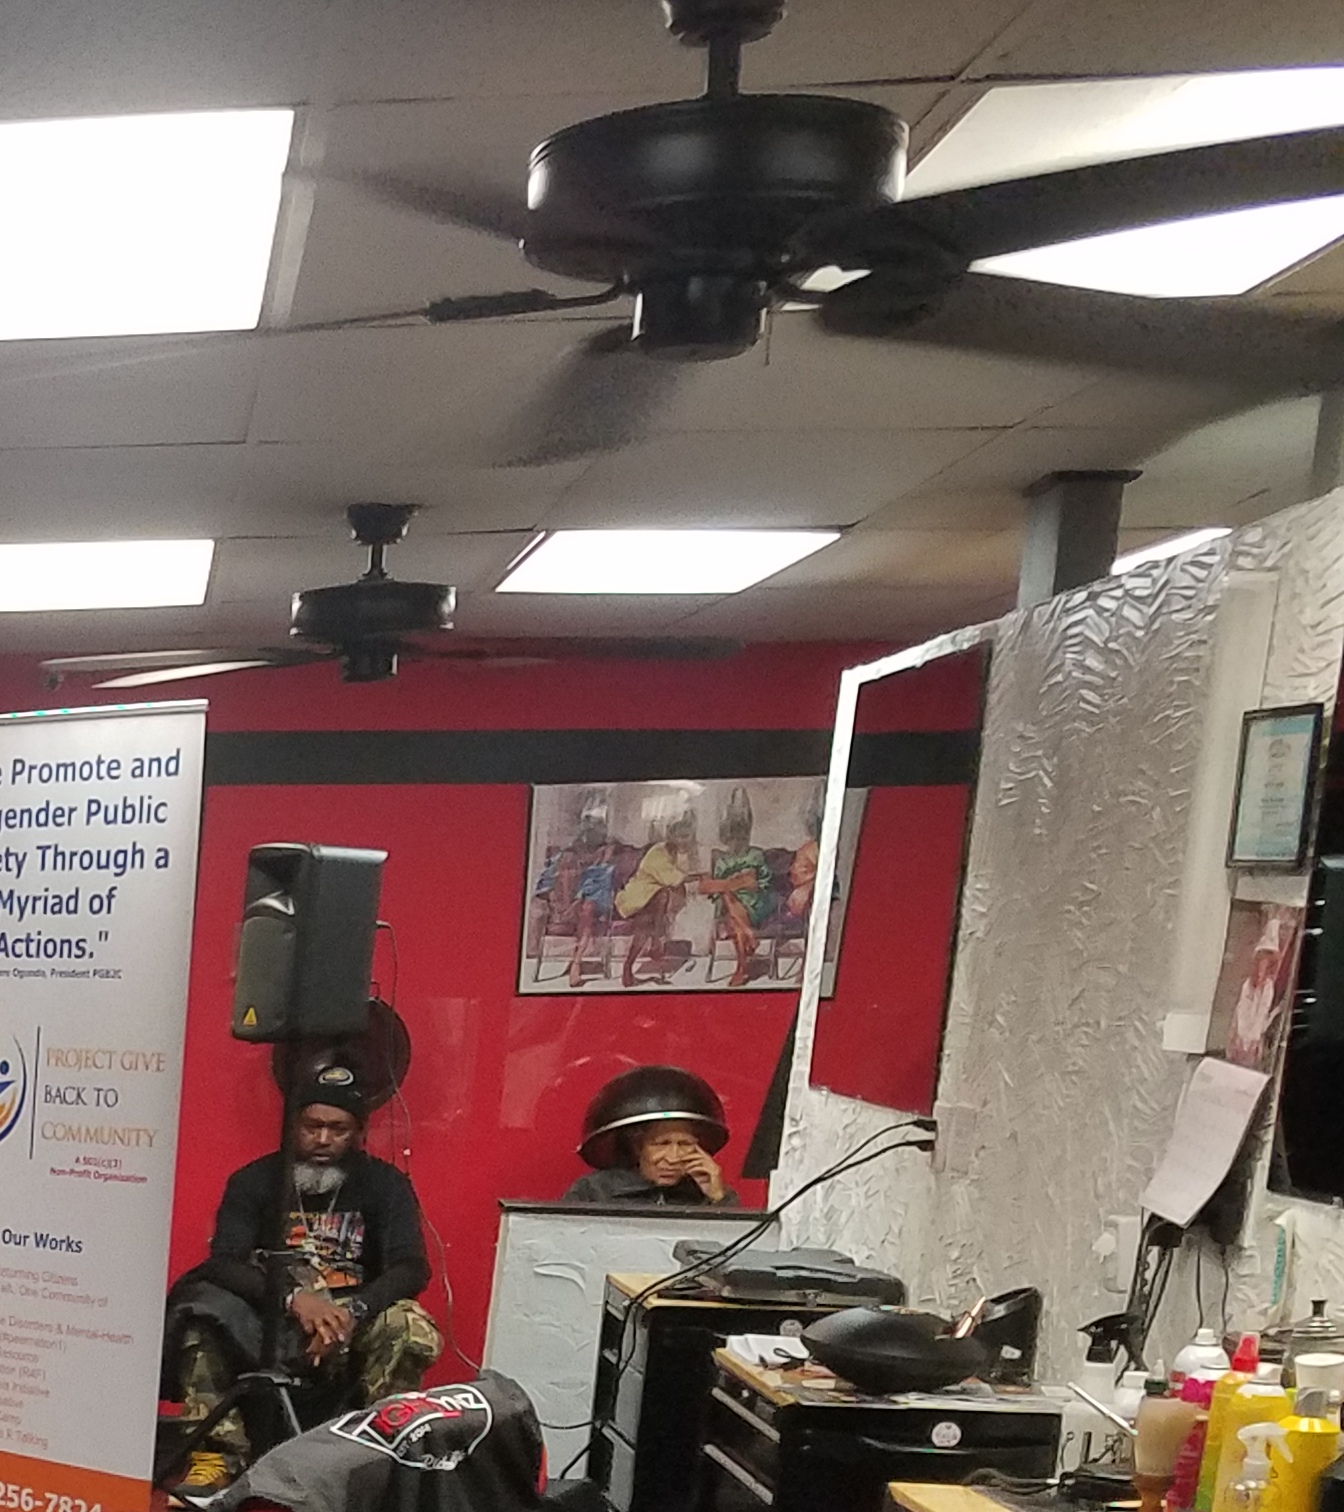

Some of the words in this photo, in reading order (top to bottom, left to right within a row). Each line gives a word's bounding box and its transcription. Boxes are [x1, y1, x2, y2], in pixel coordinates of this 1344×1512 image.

[11, 754, 122, 785] Promote
[131, 748, 181, 779] and
[86, 796, 168, 826] Public
[37, 842, 145, 877] Through
[155, 848, 170, 870] a
[88, 887, 117, 915] of
[45, 1047, 113, 1072] PROJECT
[120, 1052, 166, 1072] GIVE
[44, 1085, 87, 1106] BACK
[94, 1087, 119, 1108] TO
[40, 1121, 158, 1147] COMMUNITY
[2, 1229, 30, 1248] Our
[34, 1232, 83, 1253] Works
